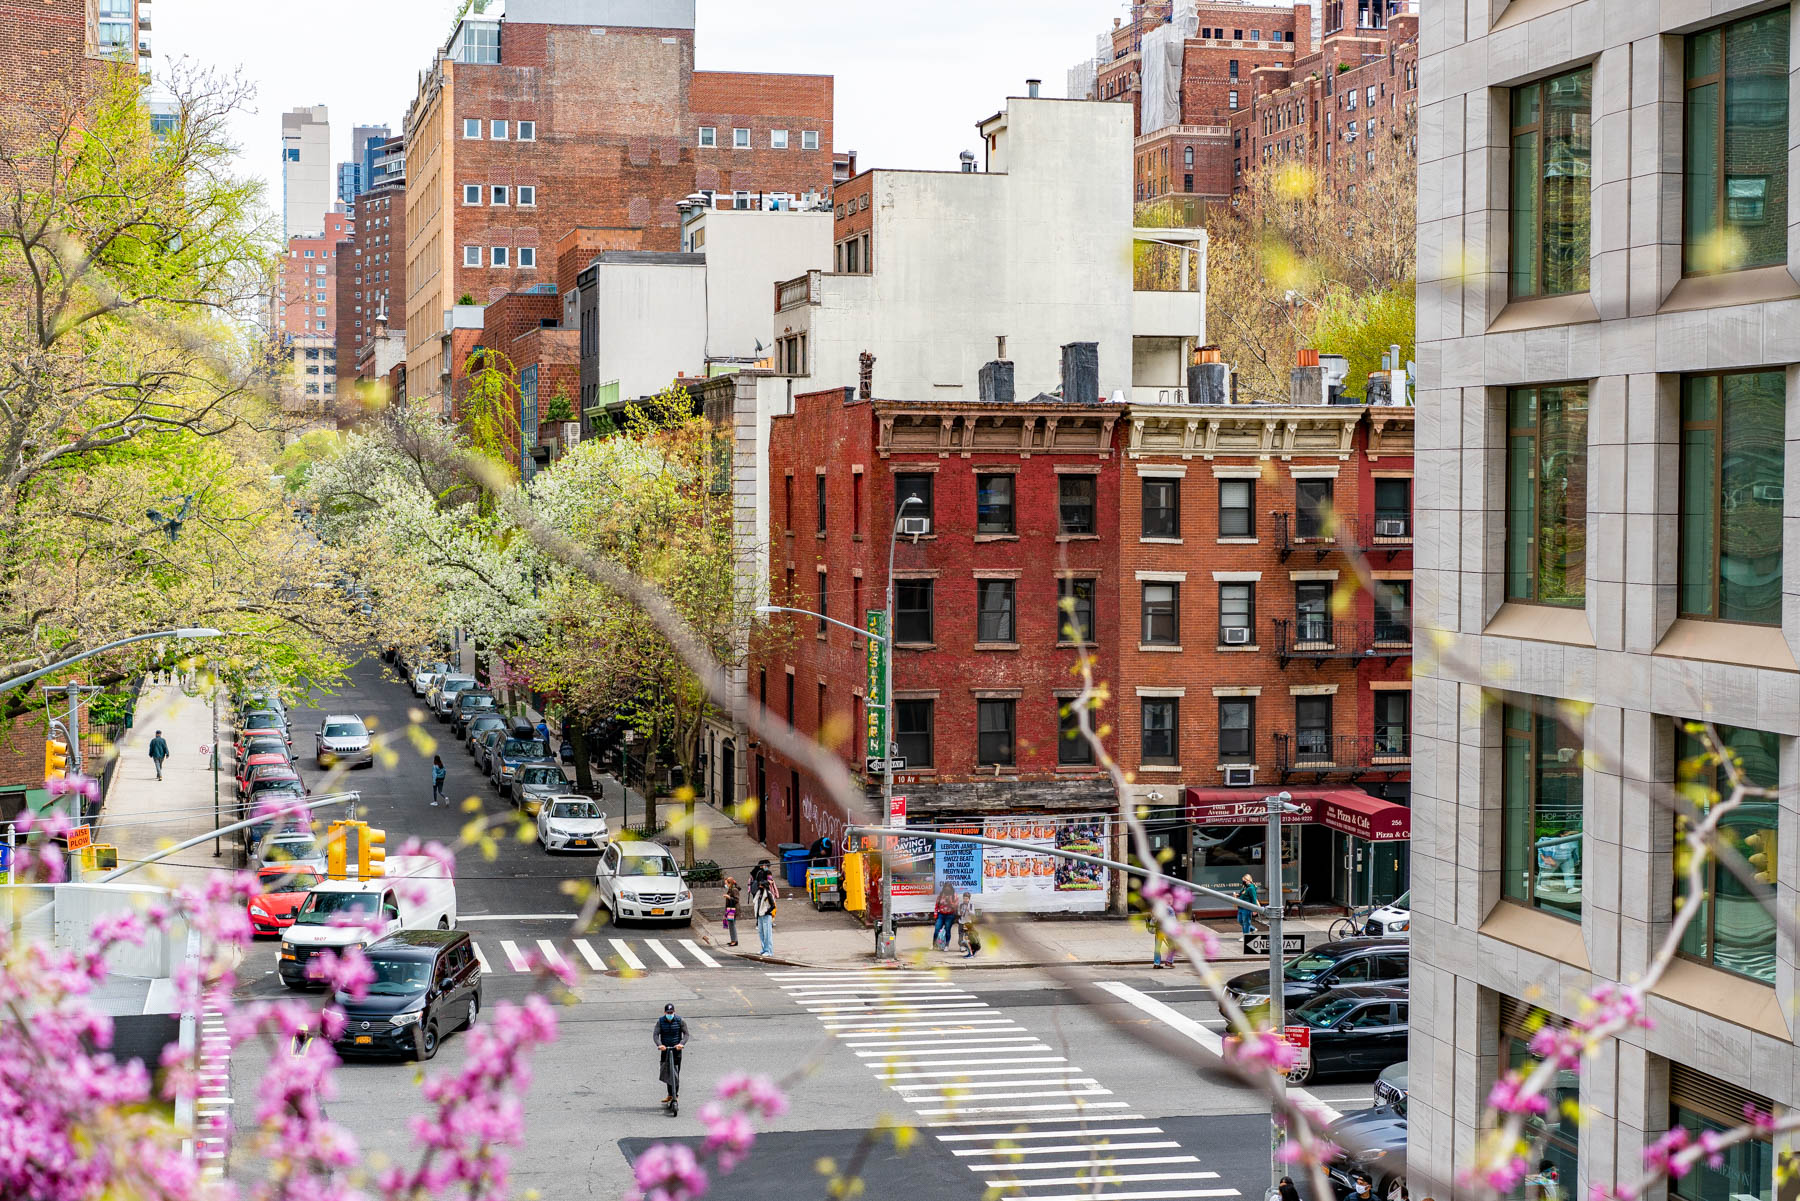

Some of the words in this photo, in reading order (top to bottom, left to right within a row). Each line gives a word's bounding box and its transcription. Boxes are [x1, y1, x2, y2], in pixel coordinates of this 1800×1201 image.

[898, 775, 905, 783] 10
[907, 775, 915, 783] Av
[1234, 803, 1267, 816] Pizza
[1337, 808, 1351, 823] Pizza
[1357, 815, 1370, 829] Cafe
[70, 829, 87, 839] RAISE
[1375, 831, 1394, 839] Pizza
[70, 836, 89, 848] PLOW
[894, 837, 926, 851] DAVINCI
[924, 844, 932, 853] 17
[1252, 940, 1270, 949] ONE
[1283, 940, 1298, 949] AY
